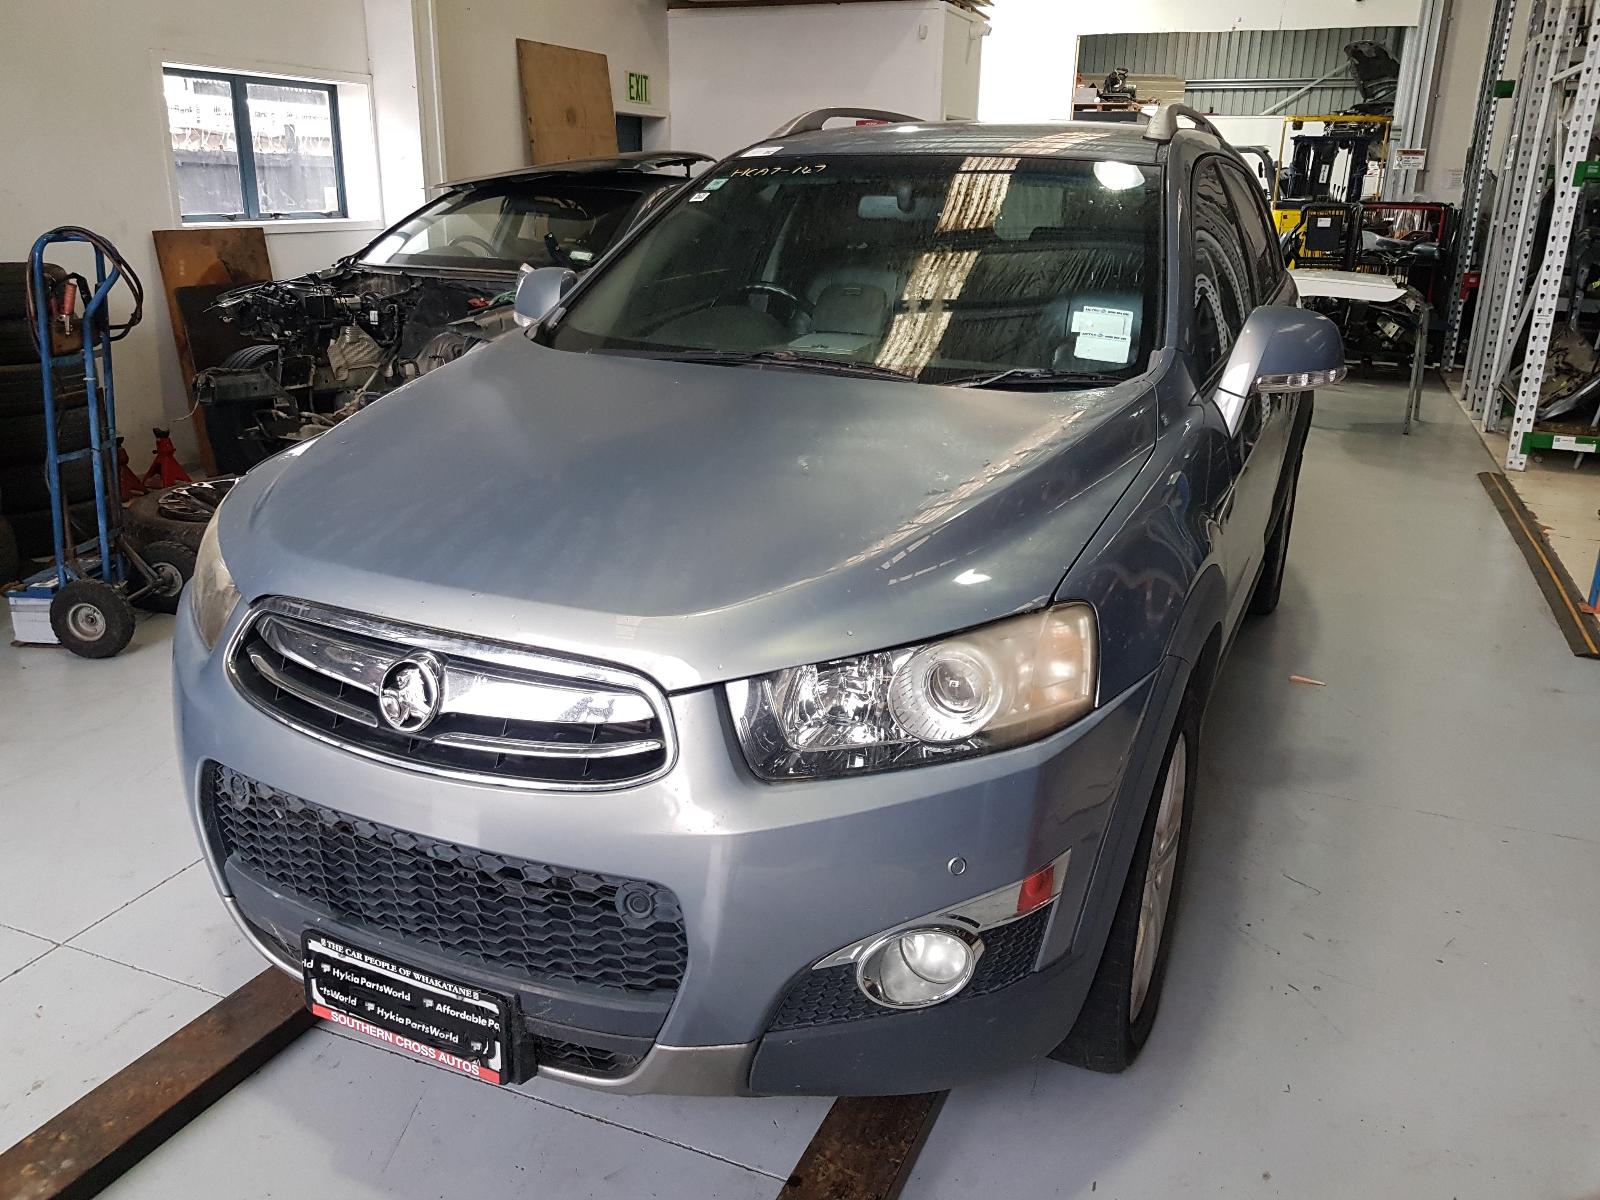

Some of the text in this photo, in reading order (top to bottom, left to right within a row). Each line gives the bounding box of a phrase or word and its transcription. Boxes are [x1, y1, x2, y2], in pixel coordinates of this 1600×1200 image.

[629, 72, 648, 102] EXIT
[327, 940, 472, 998] THE CAR PEOPLE OF WHAKATANE
[331, 1011, 480, 1076] SOUTHERN CROSS AUTOS
